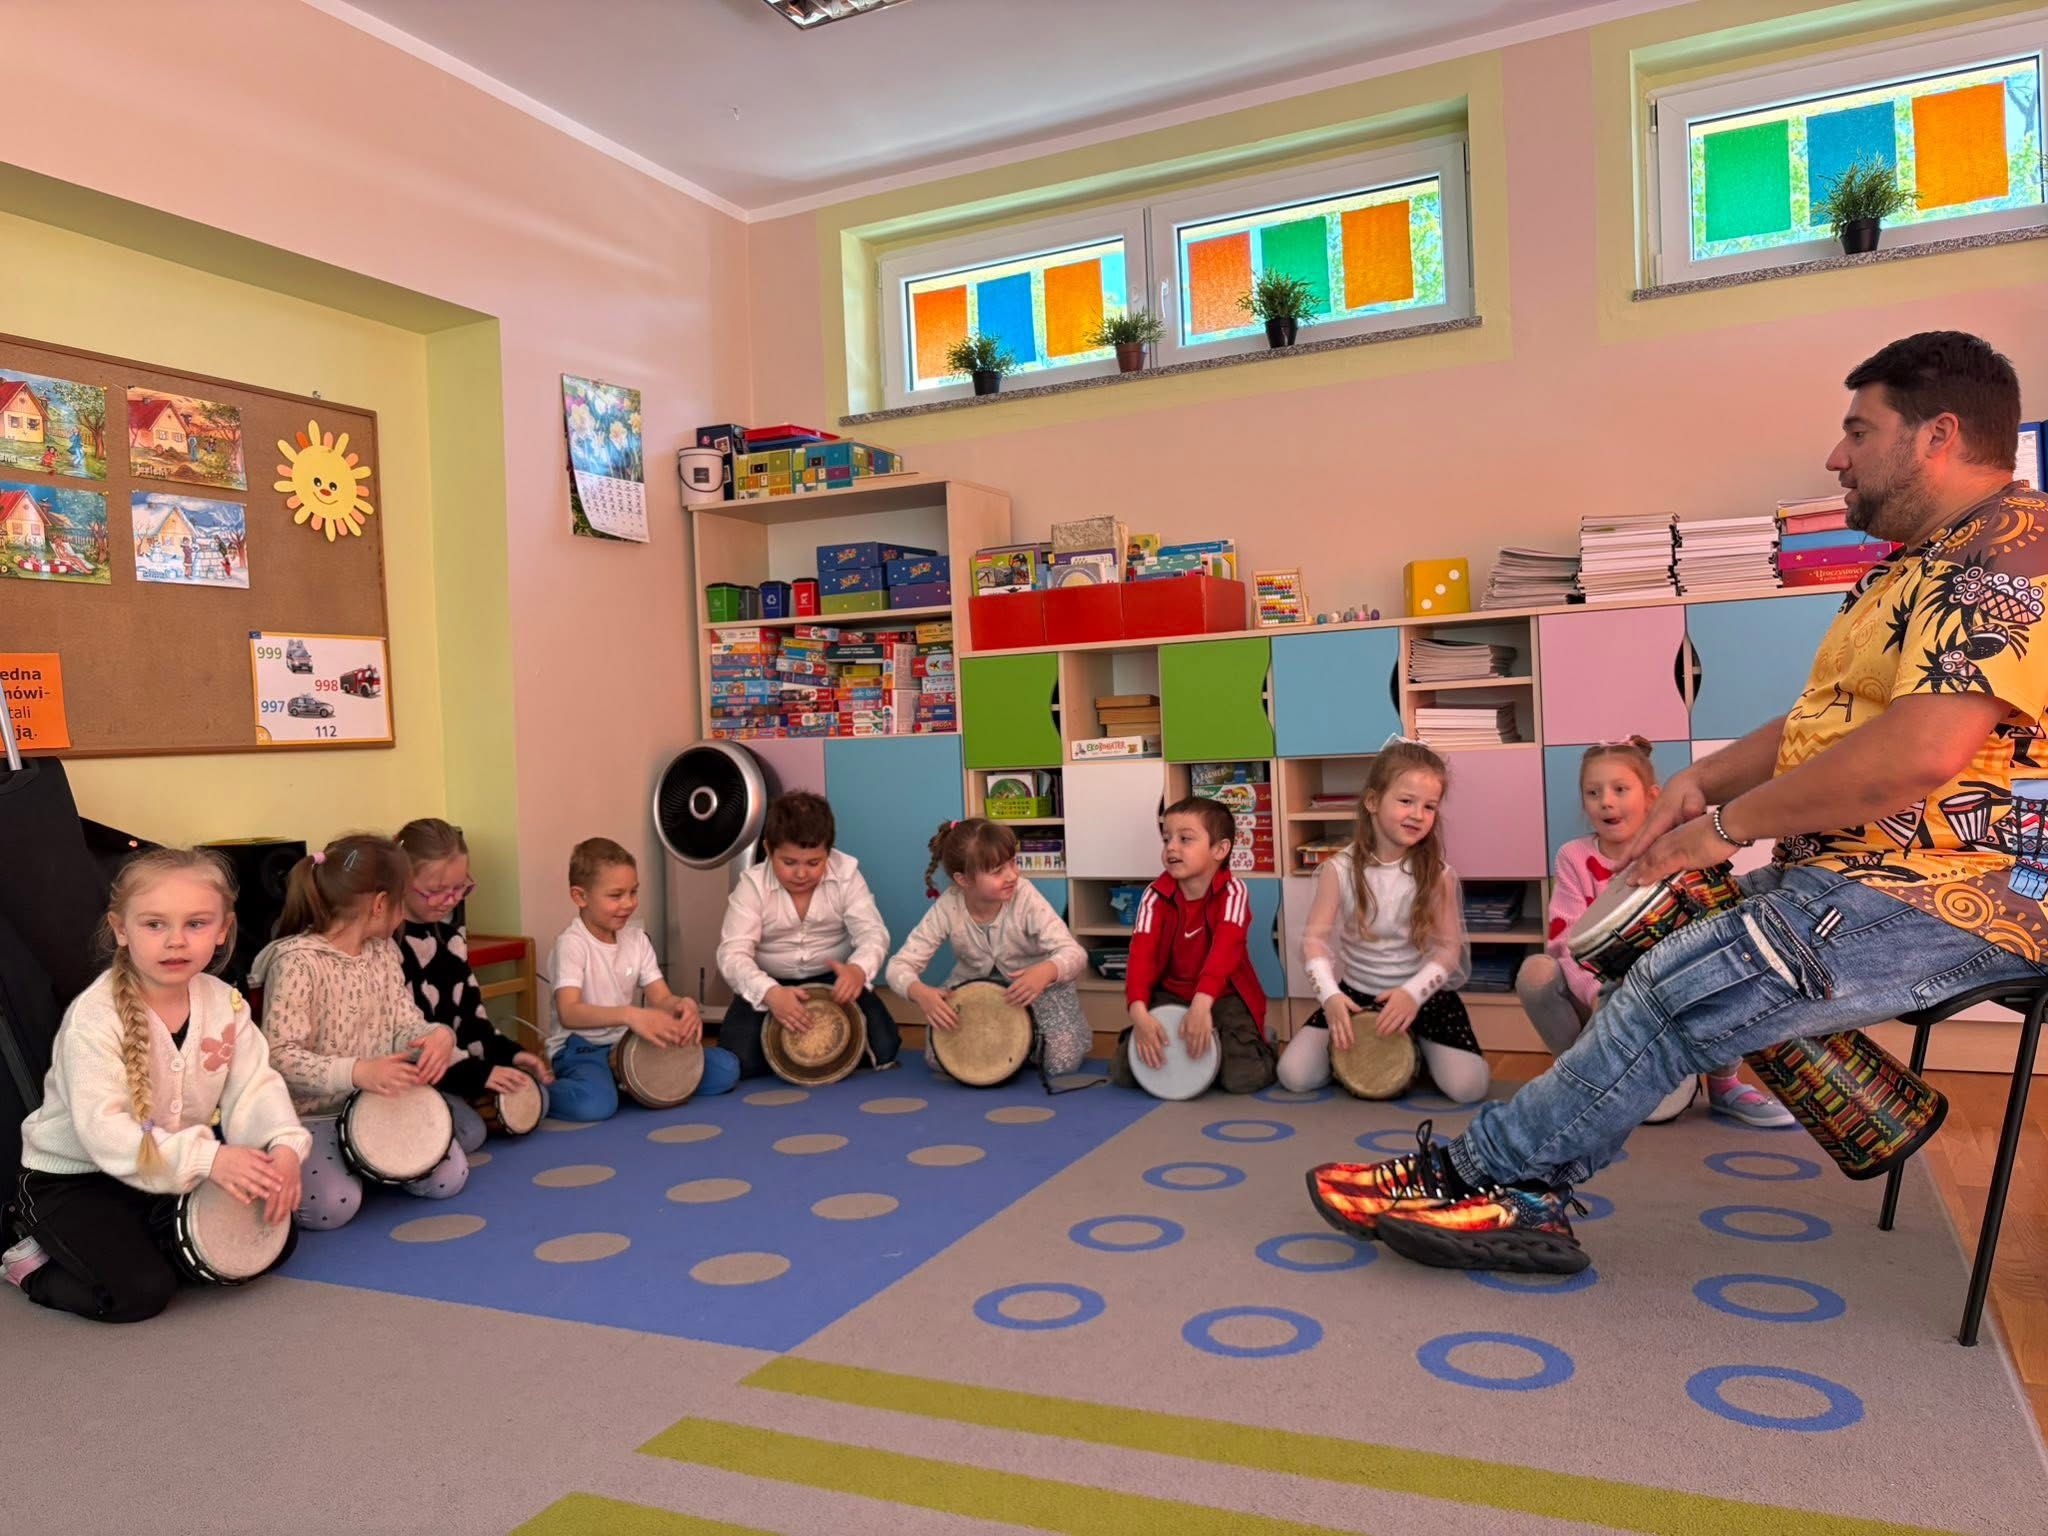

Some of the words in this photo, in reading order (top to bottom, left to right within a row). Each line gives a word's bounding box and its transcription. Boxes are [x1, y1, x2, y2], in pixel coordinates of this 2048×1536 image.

[257, 646, 282, 660] 999
[0, 668, 42, 681] edna
[314, 679, 339, 692] 998
[261, 700, 285, 713] 997
[315, 725, 337, 737] 112
